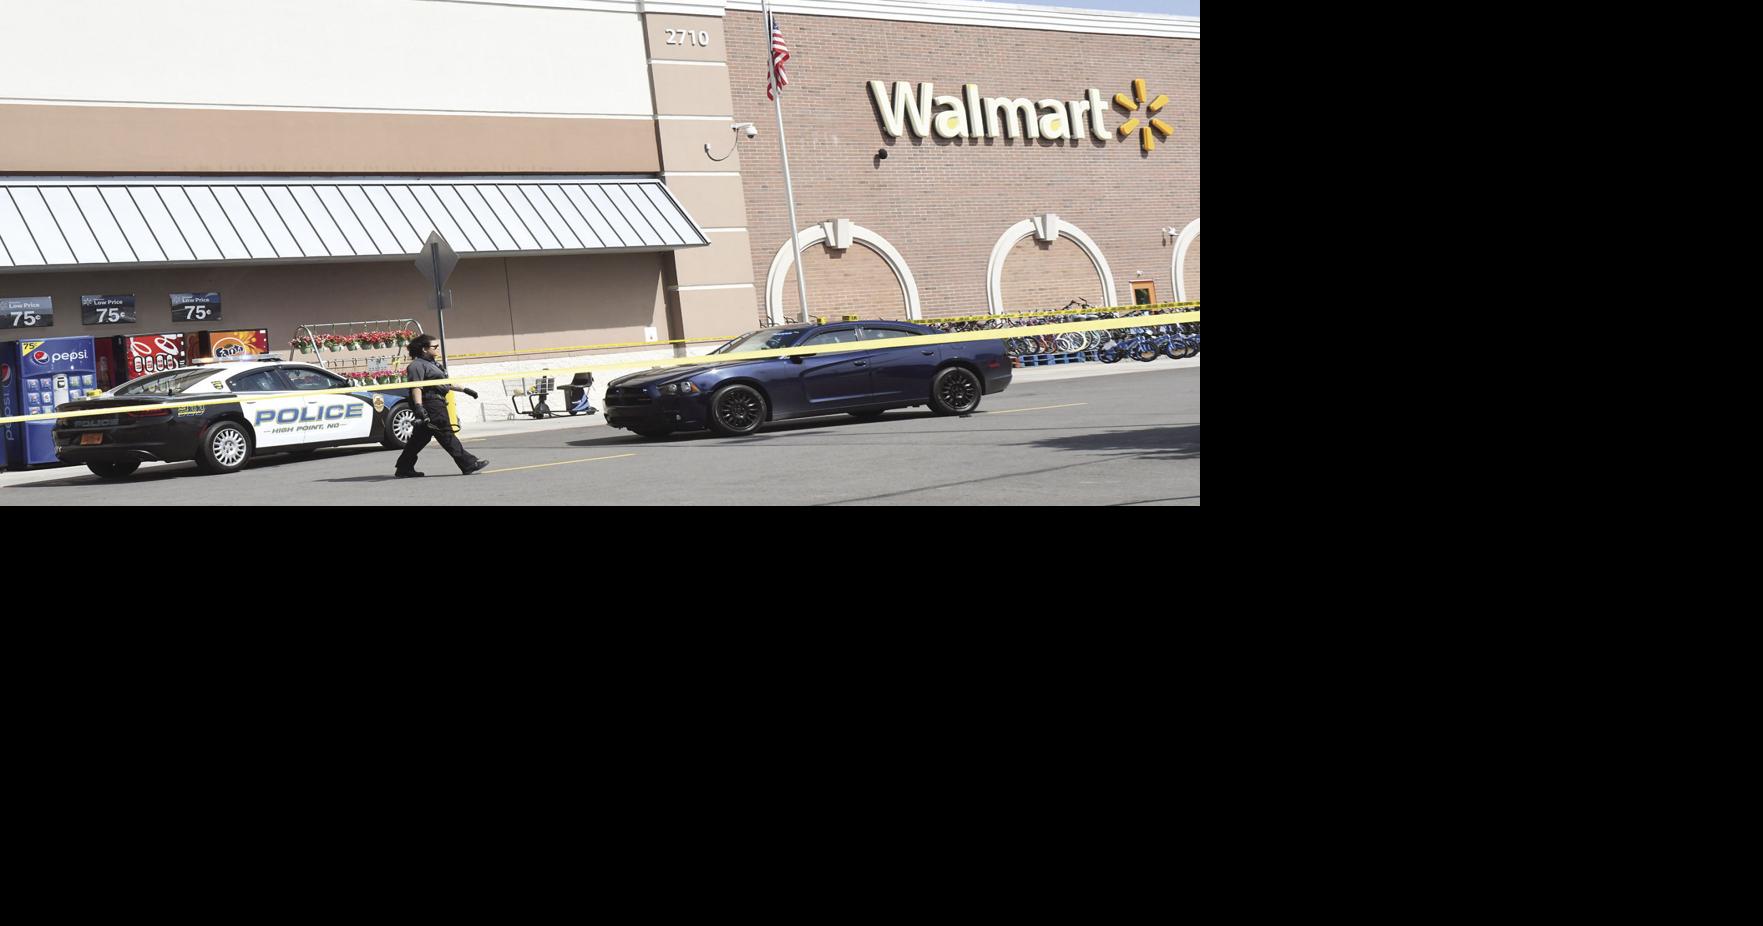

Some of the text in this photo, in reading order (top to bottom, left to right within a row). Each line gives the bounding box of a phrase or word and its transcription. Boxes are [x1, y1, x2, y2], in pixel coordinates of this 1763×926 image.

[665, 28, 709, 47] 2710
[867, 80, 1112, 140] Walmart
[51, 349, 88, 363] pepsi
[255, 402, 364, 426] POLICE
[271, 426, 294, 434] HIGH
